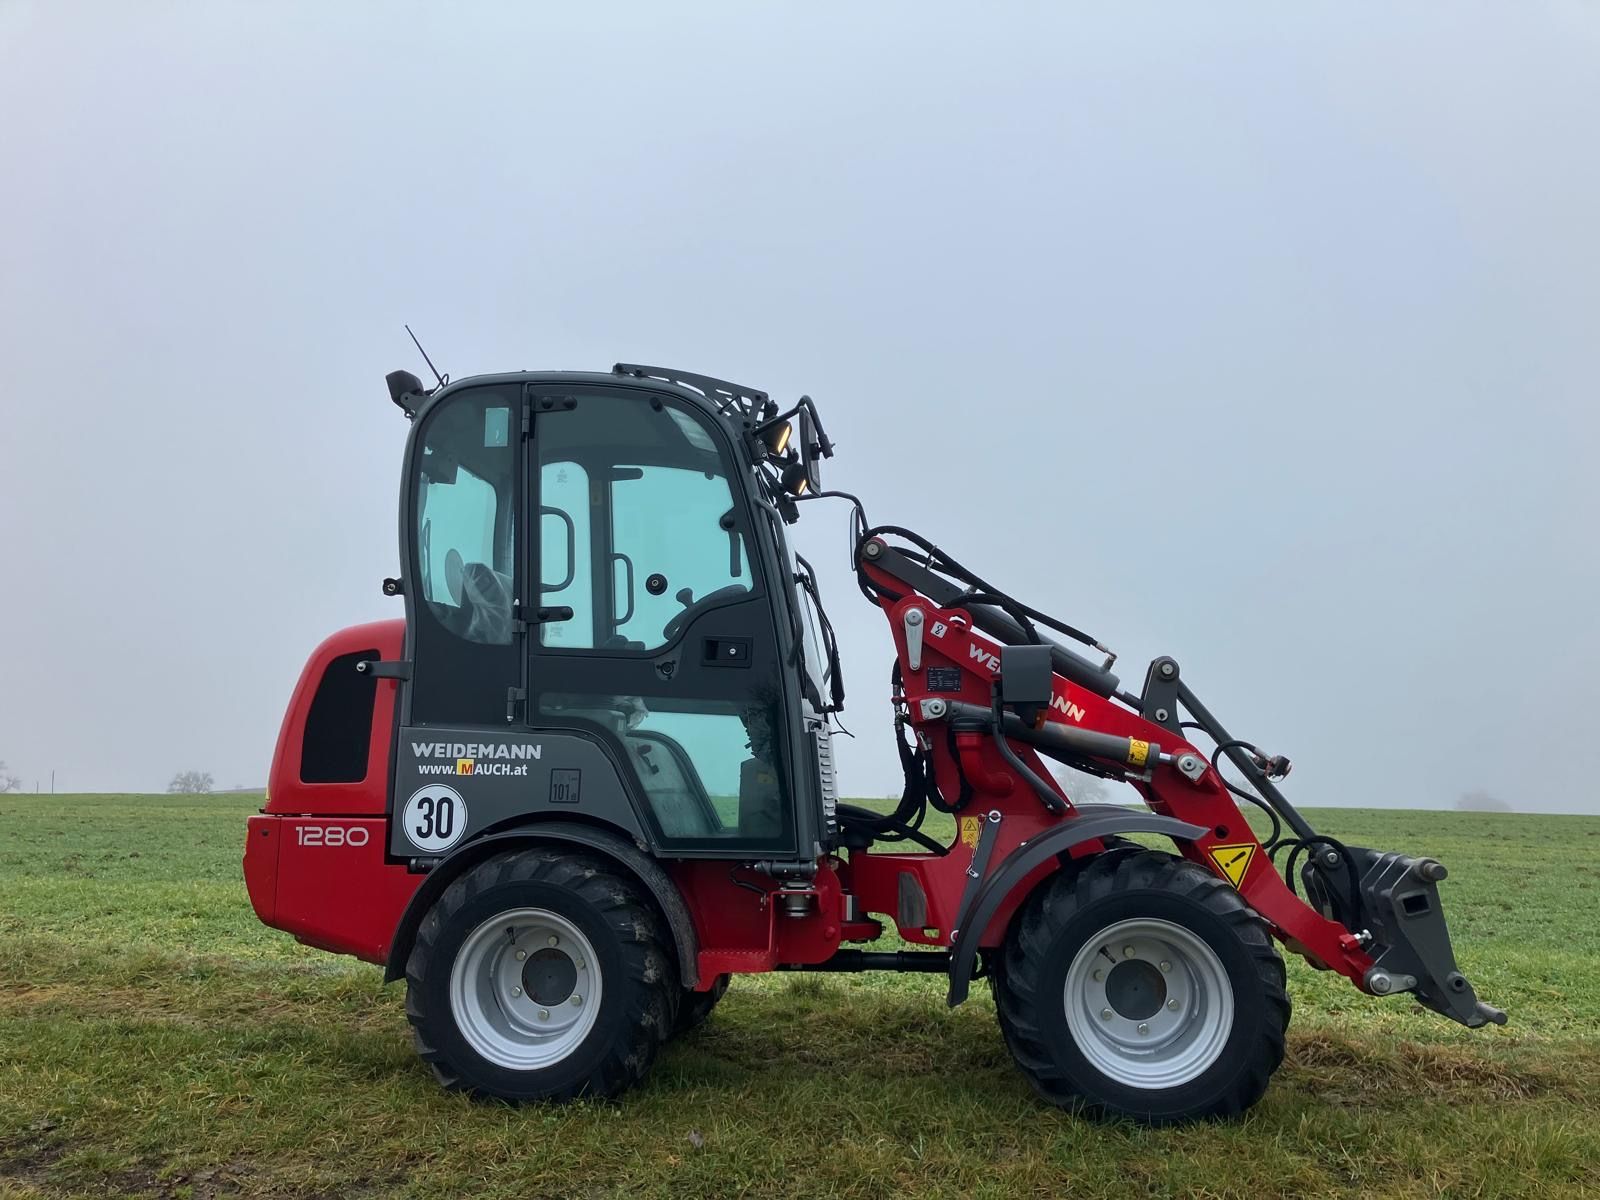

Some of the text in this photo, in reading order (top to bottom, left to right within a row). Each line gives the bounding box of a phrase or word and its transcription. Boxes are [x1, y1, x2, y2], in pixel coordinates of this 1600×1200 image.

[411, 742, 542, 760] WEIDEMANN
[418, 762, 528, 777] www.MAUCH.at
[553, 783, 570, 801] 101
[415, 796, 454, 840] 30
[295, 826, 369, 847] 1280
